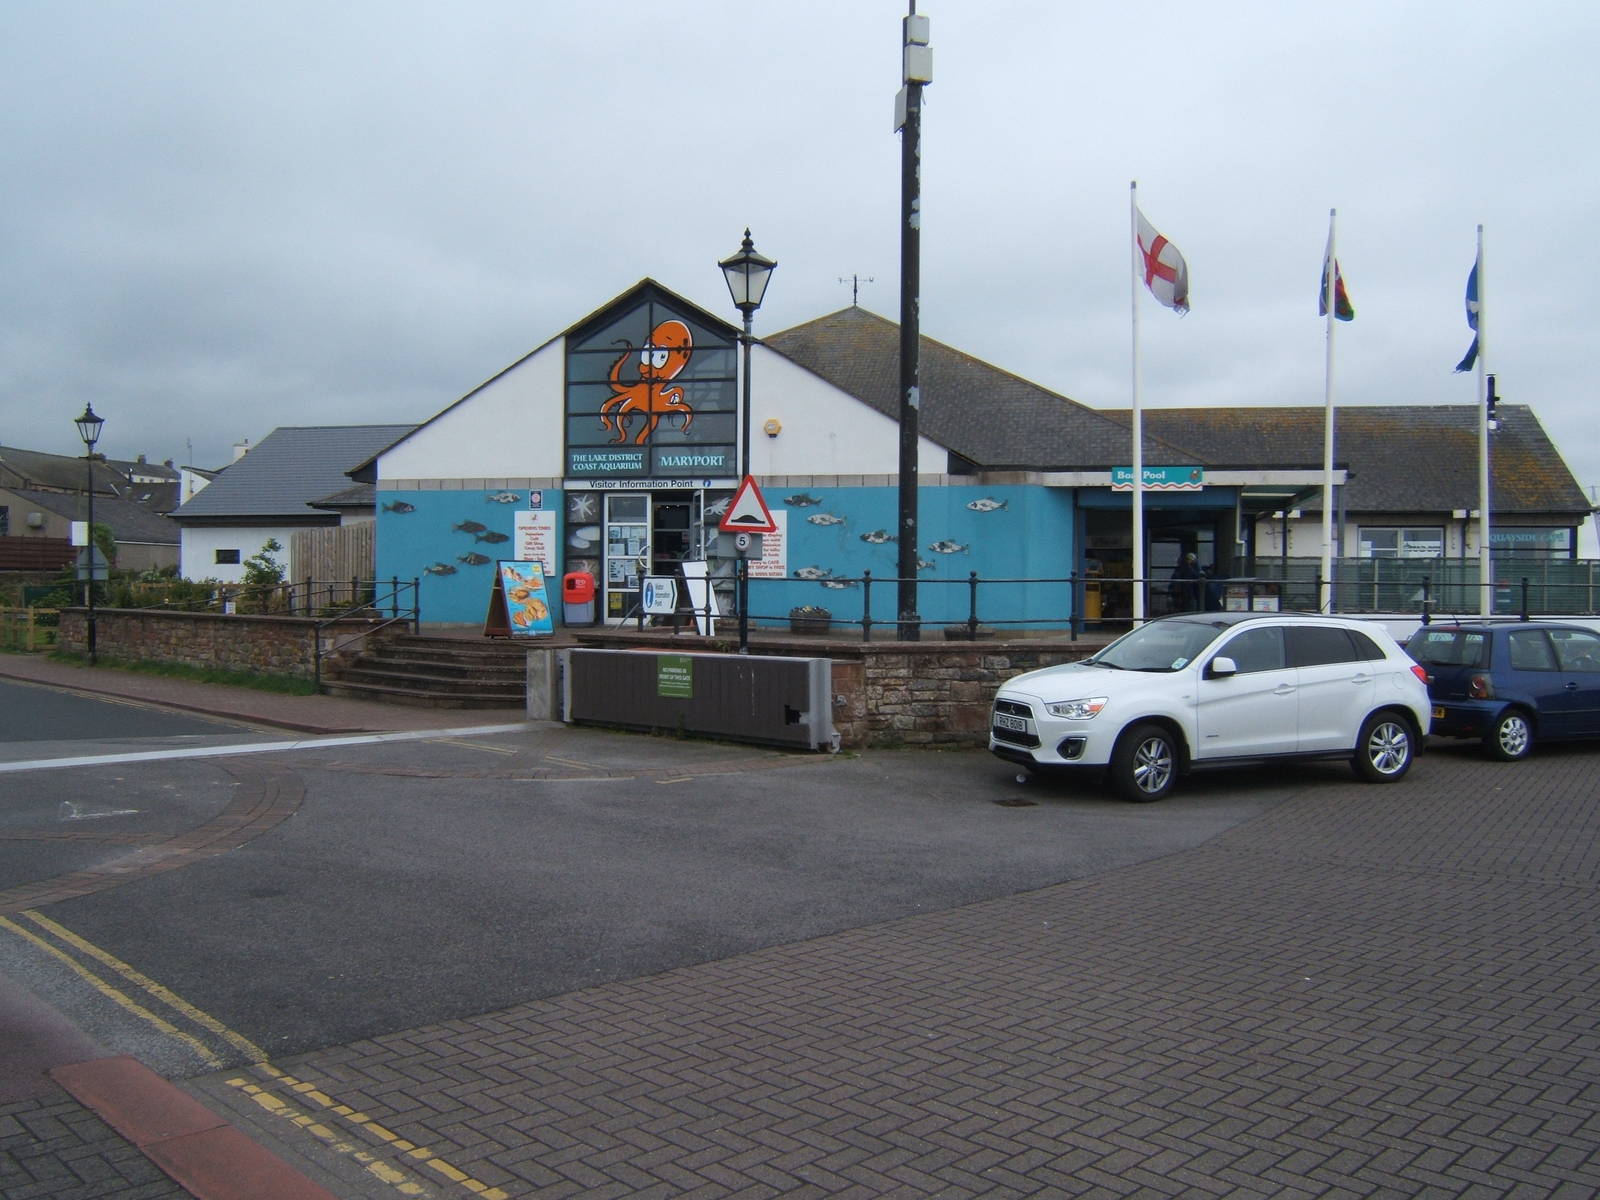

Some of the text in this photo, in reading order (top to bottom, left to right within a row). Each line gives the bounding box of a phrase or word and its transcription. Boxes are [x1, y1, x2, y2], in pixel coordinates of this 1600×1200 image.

[573, 453, 643, 462] THE LAKE DISTRICT
[661, 455, 725, 467] MARYPORT
[573, 462, 642, 471] COAST AQUARIUM
[1143, 471, 1166, 480] Pool
[590, 480, 693, 489] Visitor Information Point
[739, 536, 746, 546] 5
